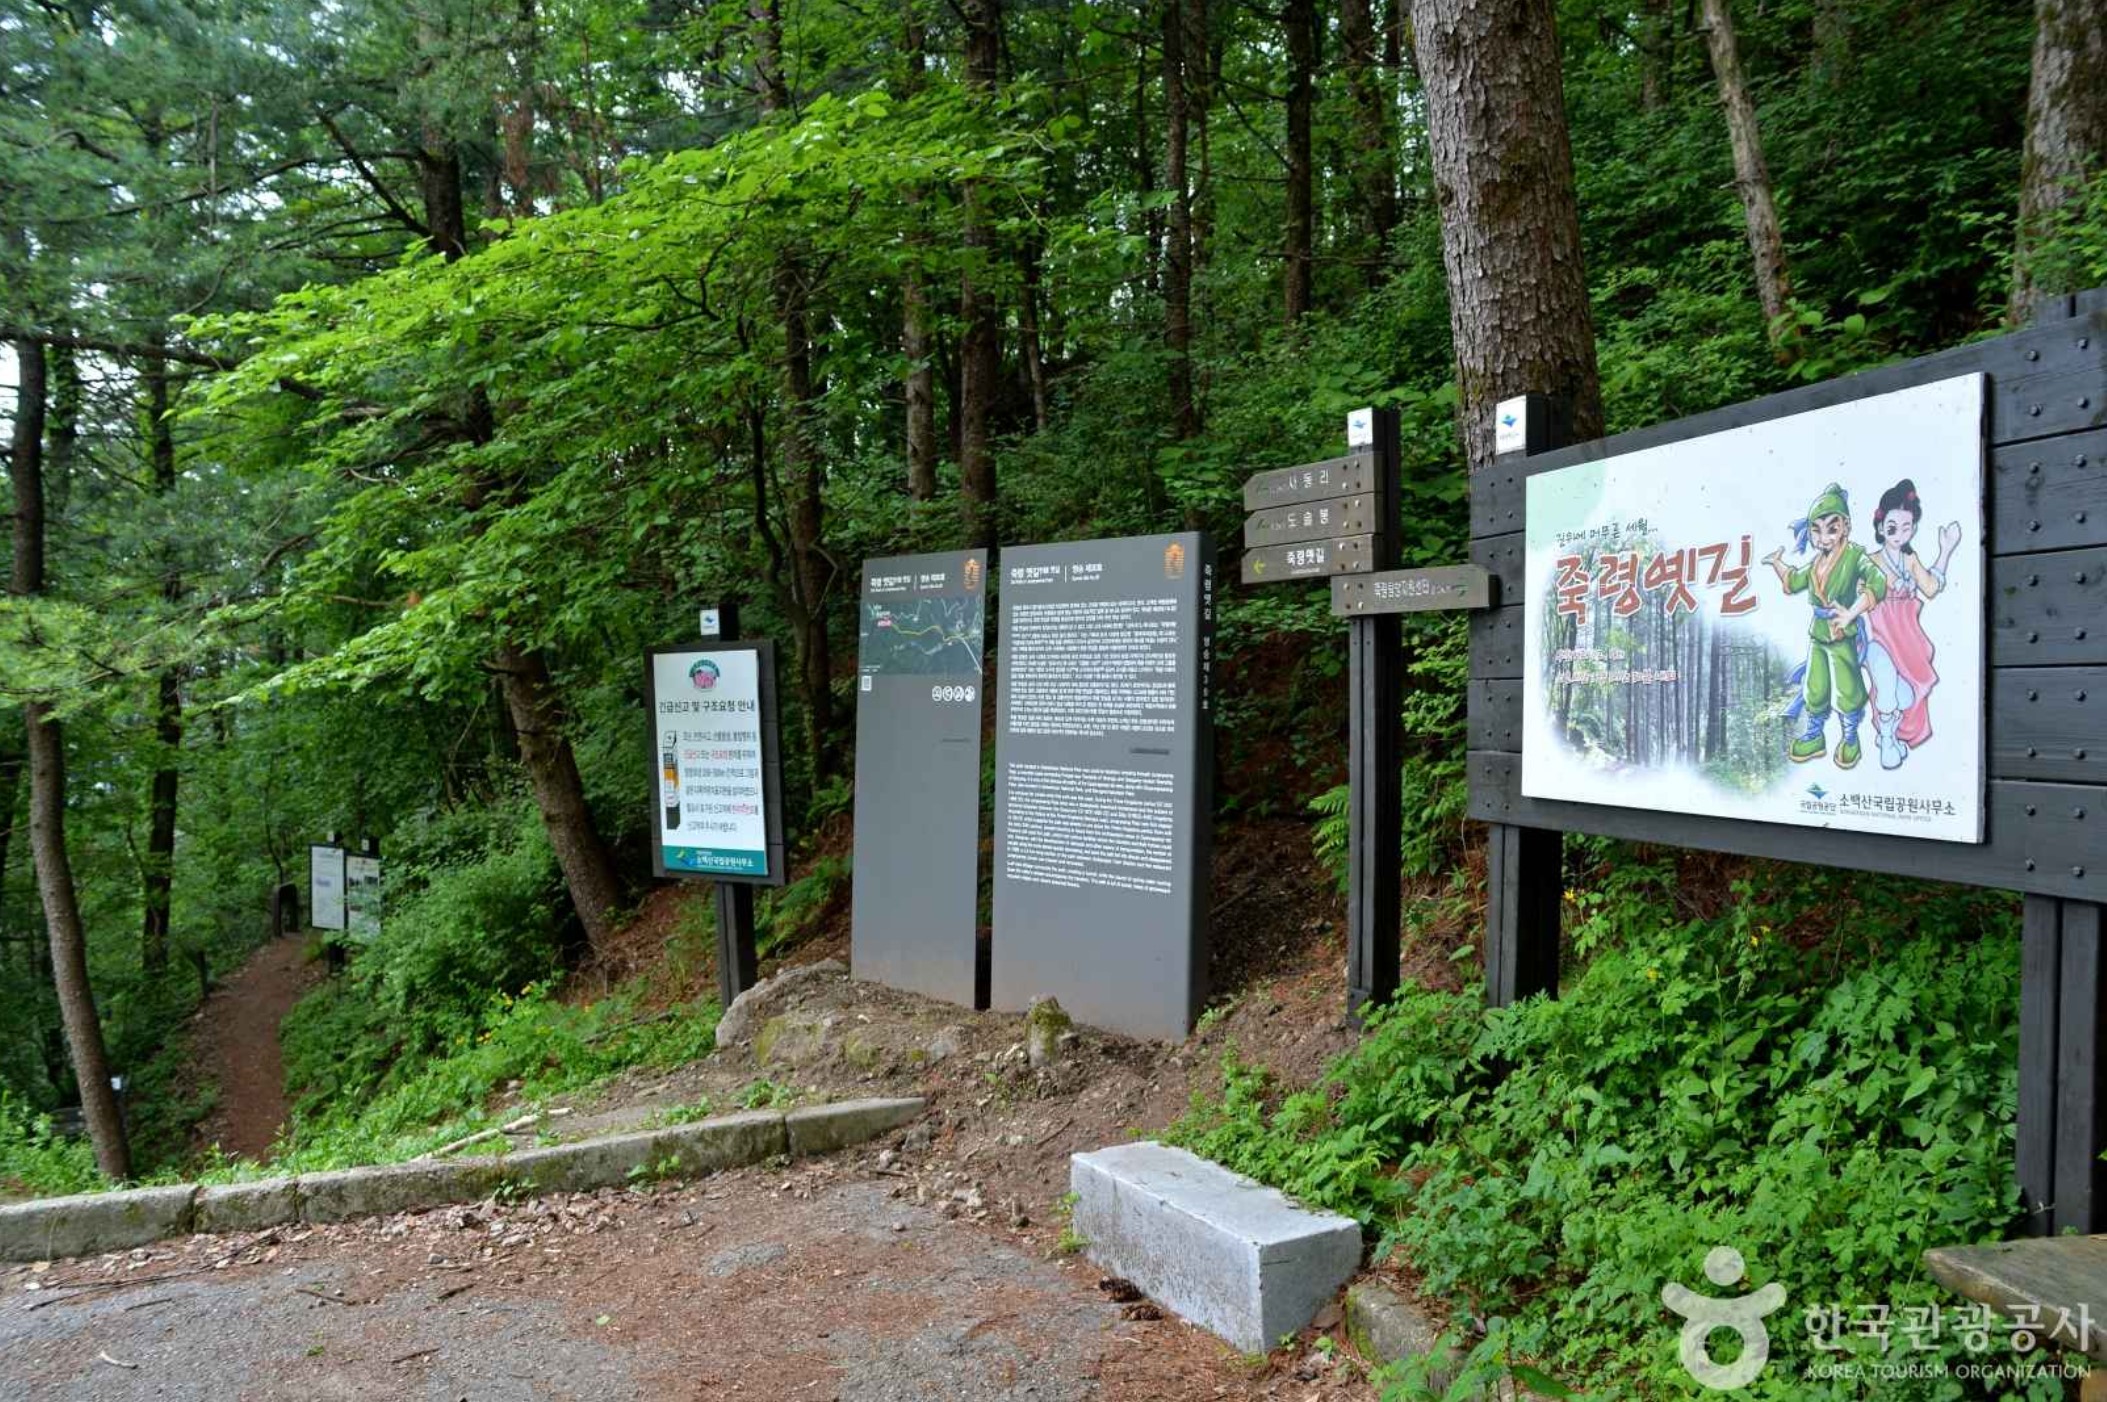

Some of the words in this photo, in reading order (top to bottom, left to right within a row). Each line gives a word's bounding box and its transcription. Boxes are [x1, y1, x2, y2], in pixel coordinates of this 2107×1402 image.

[1286, 547, 1325, 566] 죽령옛길
[1555, 532, 1759, 626] 죽령옛길
[658, 700, 689, 714] 긴급신고
[691, 700, 700, 712] 및
[702, 699, 735, 713] 구조요청
[737, 698, 755, 713] 안내
[1839, 793, 1957, 816] 소백산국립공원사무소
